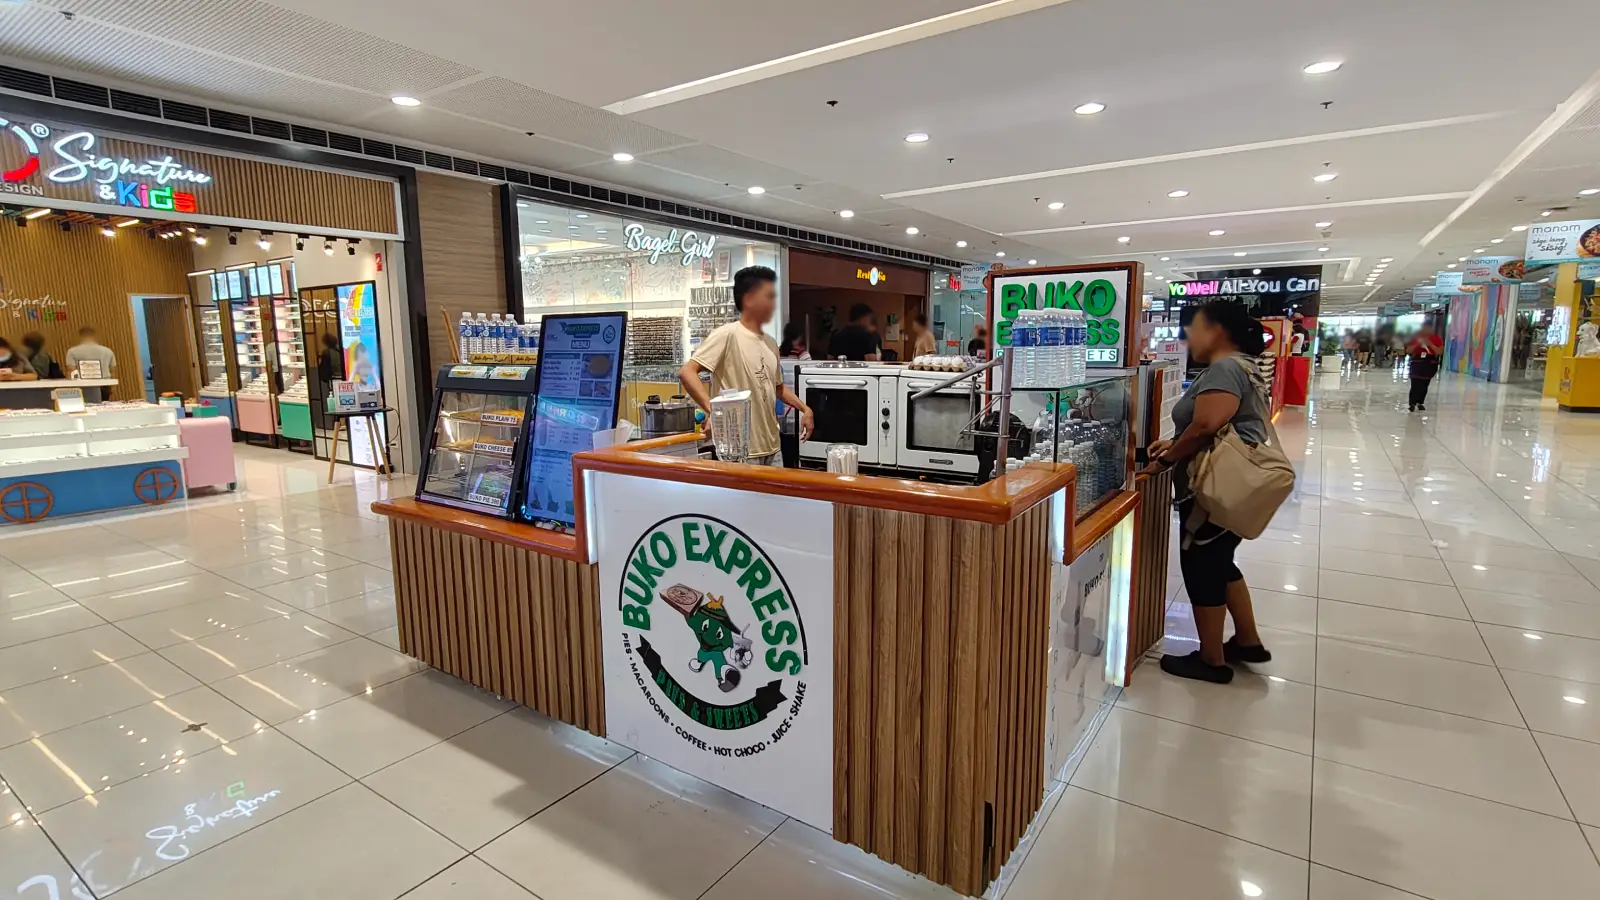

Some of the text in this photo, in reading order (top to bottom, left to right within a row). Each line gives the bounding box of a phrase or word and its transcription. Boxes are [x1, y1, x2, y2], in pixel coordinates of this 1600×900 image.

[49, 131, 212, 185] Signature
[99, 179, 197, 213] & Kids
[624, 223, 716, 266] Bagel Girl
[1531, 224, 1581, 234] manam
[1001, 278, 1117, 318] BUKO
[1168, 281, 1219, 296] YoWell
[1248, 279, 1281, 293] You
[1286, 277, 1320, 292] Can
[572, 340, 590, 349] MENU
[621, 522, 803, 676] BUKO EXPRESS
[621, 632, 807, 758] PIES MACAROONS COFFEE HOT CHOCO JUICE SHAKE
[690, 701, 700, 721] &
[706, 701, 760, 729] SWEETS
